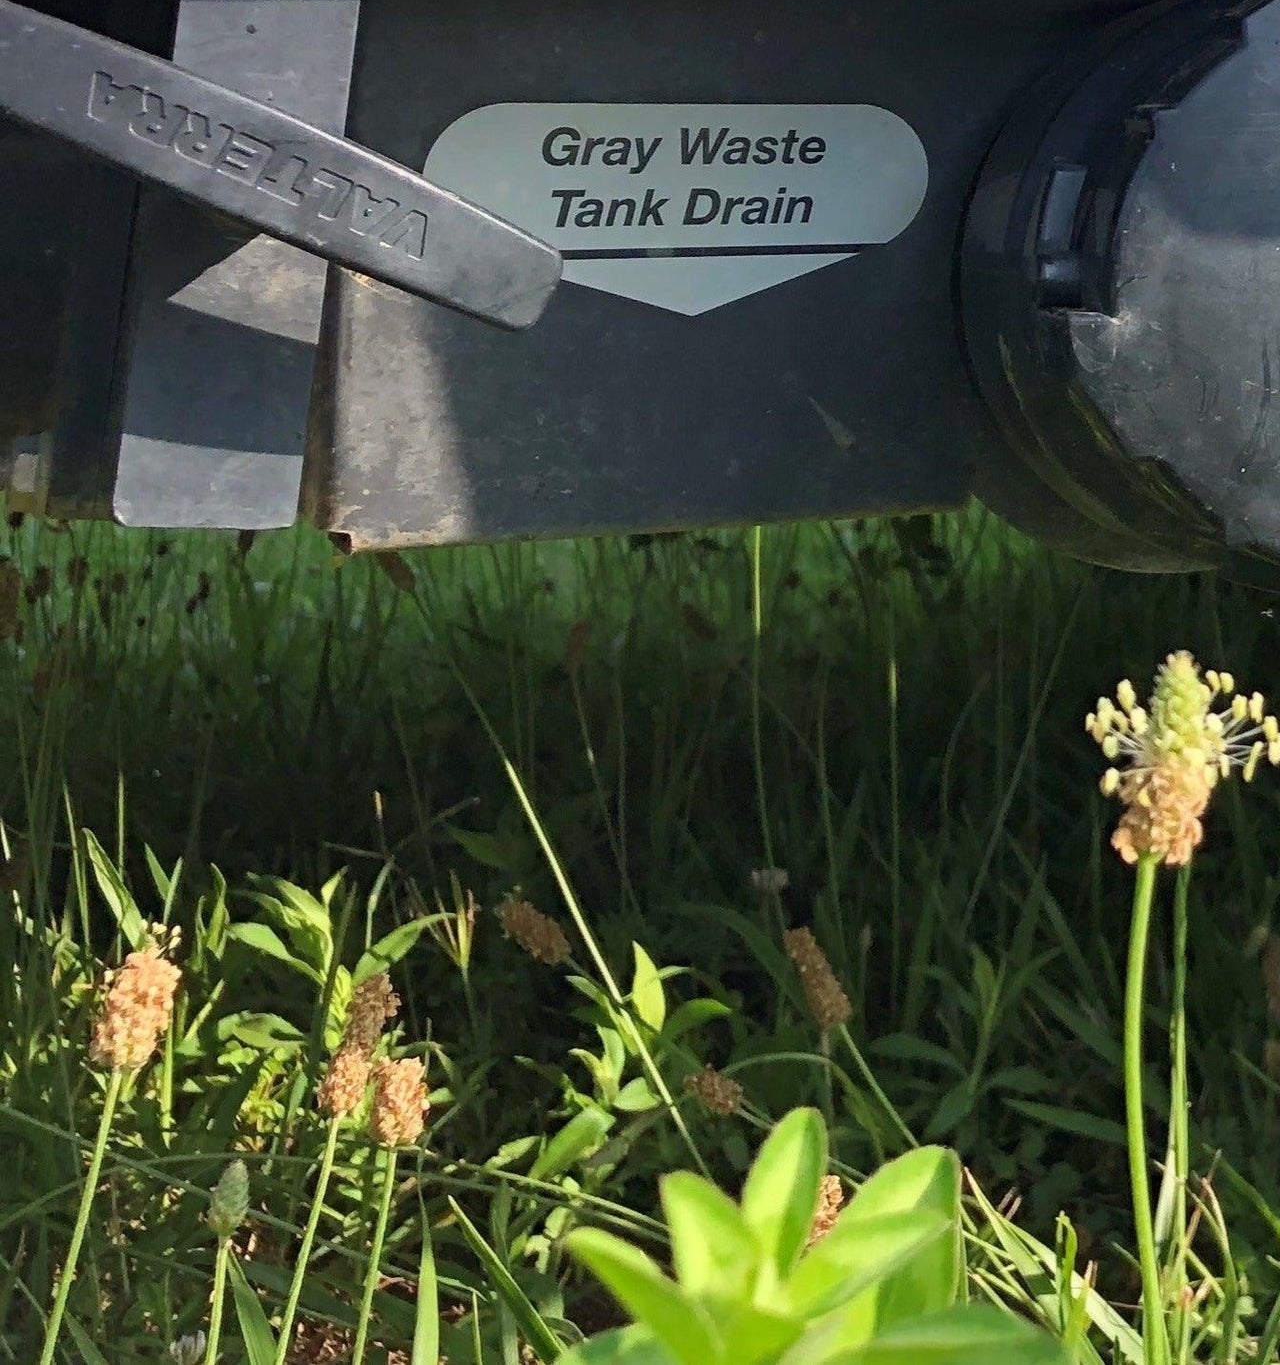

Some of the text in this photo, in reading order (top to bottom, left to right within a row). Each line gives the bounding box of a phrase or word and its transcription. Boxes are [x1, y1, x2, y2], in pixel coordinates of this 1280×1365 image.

[87, 70, 428, 261] VALTERRA
[541, 126, 827, 175] Gray Waste
[550, 186, 813, 228] Tank Drain
